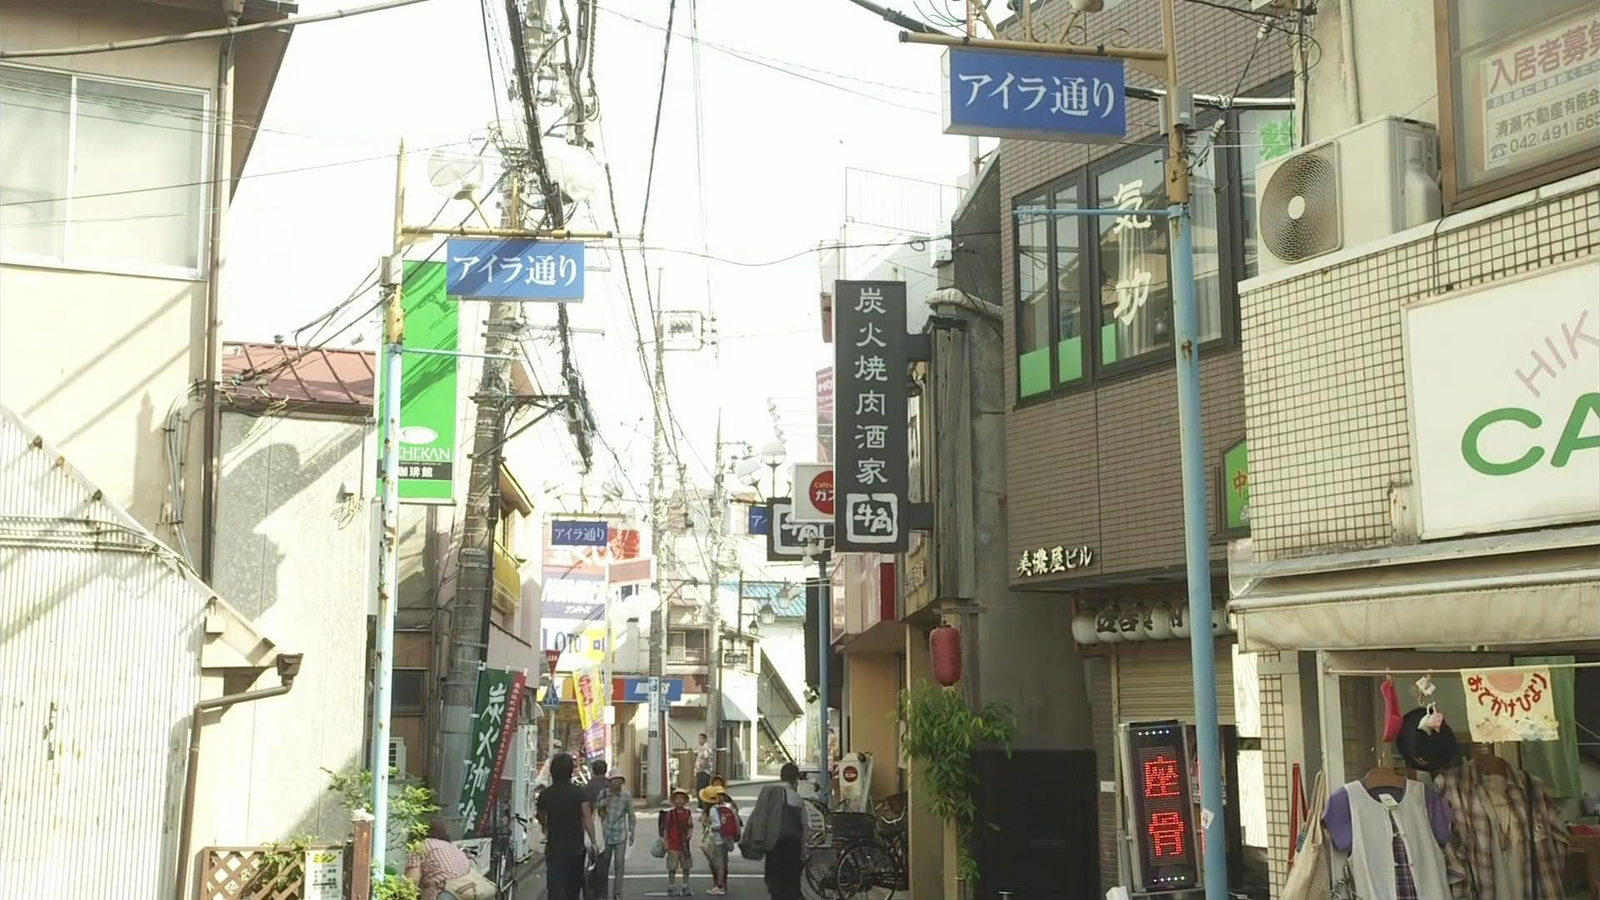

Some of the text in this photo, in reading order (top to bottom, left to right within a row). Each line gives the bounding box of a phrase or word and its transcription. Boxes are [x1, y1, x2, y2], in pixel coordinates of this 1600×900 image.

[958, 72, 1115, 118] アイラ通り
[453, 254, 577, 287] アイラ通り
[1113, 179, 1151, 326] 気功
[1514, 309, 1600, 397] HIK
[854, 287, 888, 485] 炭火焼肉酒家
[554, 527, 605, 541] アイラ通り
[853, 503, 892, 533] 牛角
[1016, 546, 1092, 577] 美濃屋ビル
[1144, 755, 1185, 856] 座骨
